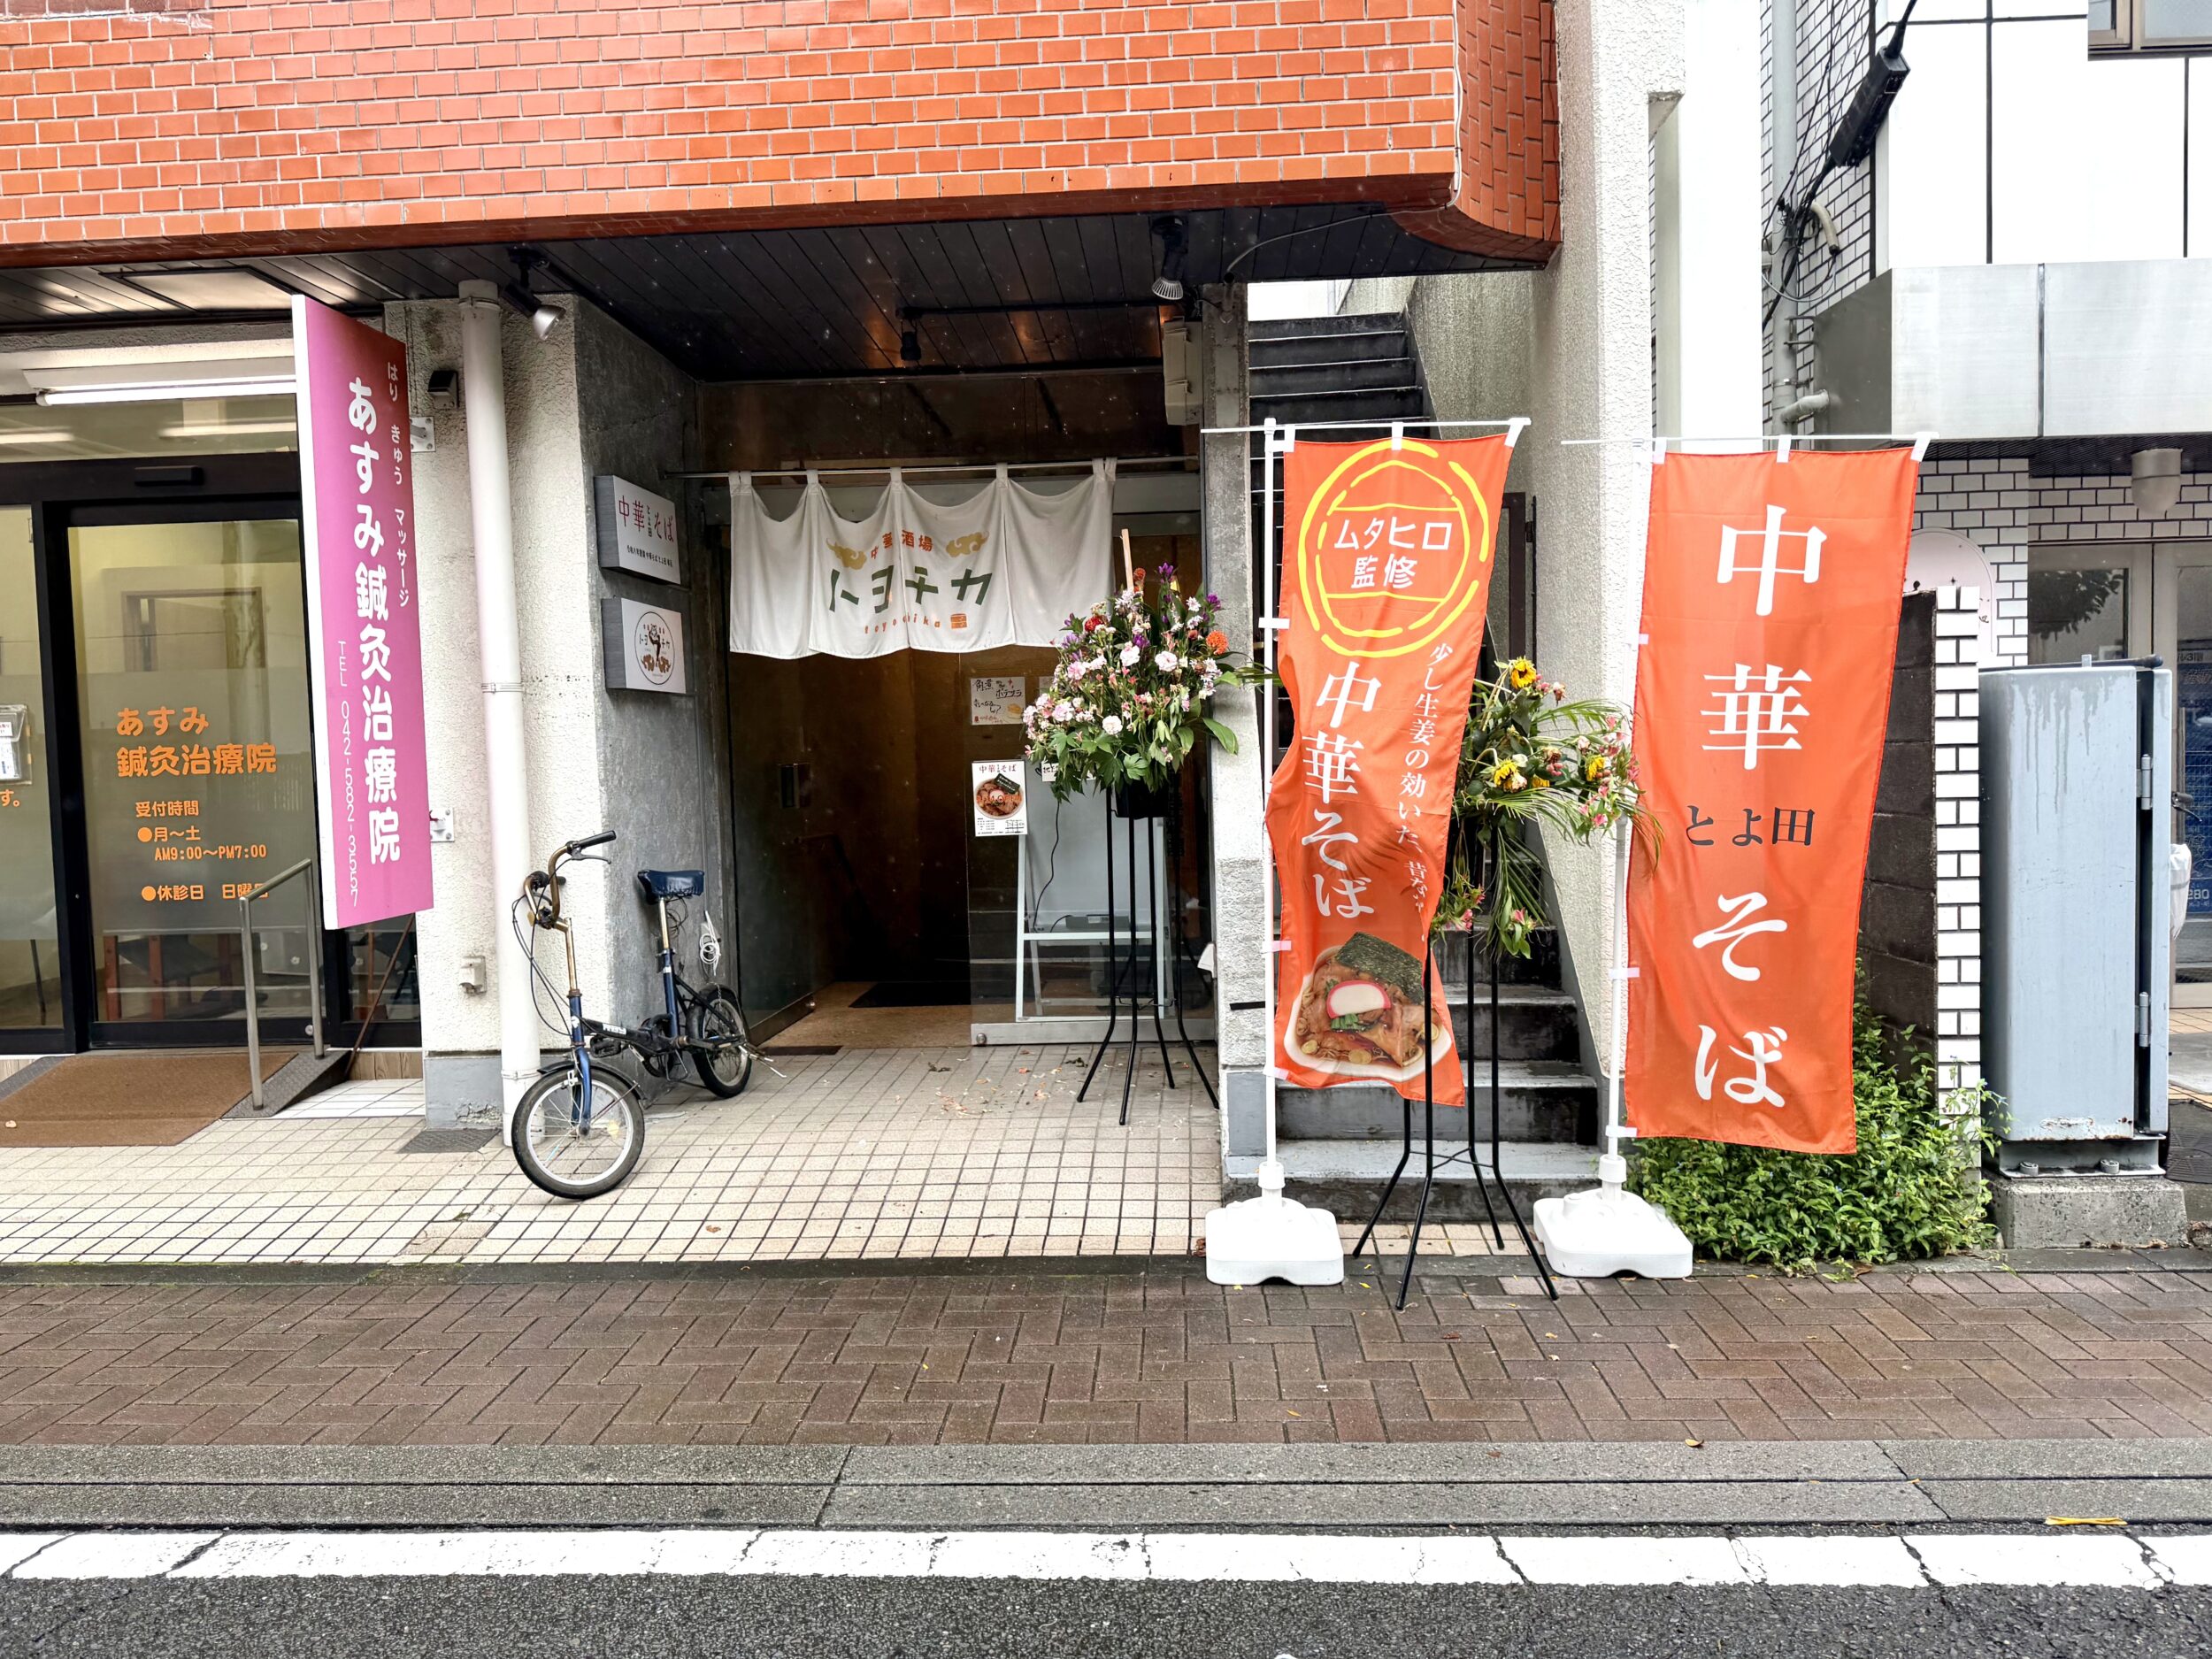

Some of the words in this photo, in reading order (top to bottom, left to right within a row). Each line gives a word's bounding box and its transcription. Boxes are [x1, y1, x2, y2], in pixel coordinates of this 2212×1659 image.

[388, 362, 397, 402] はり
[391, 424, 403, 485] きゅう
[1333, 516, 1453, 550] ムタヒロ
[395, 508, 410, 608] マッサージ
[1351, 554, 1417, 589] 監修
[828, 565, 993, 614] トヨチカ
[348, 376, 402, 865] あすみ鍼灸治療院
[1701, 503, 1827, 771] 中華
[338, 641, 348, 687] TEL
[116, 706, 210, 736] あすみ
[116, 741, 277, 778] 鍼灸治療院
[135, 800, 199, 818] 受付時間
[341, 700, 358, 907] 042-582-3557
[1302, 660, 1383, 919] 中華そば
[1686, 805, 1815, 847] とよ田
[157, 885, 204, 901] 休診日
[1693, 892, 1788, 1108] そば
